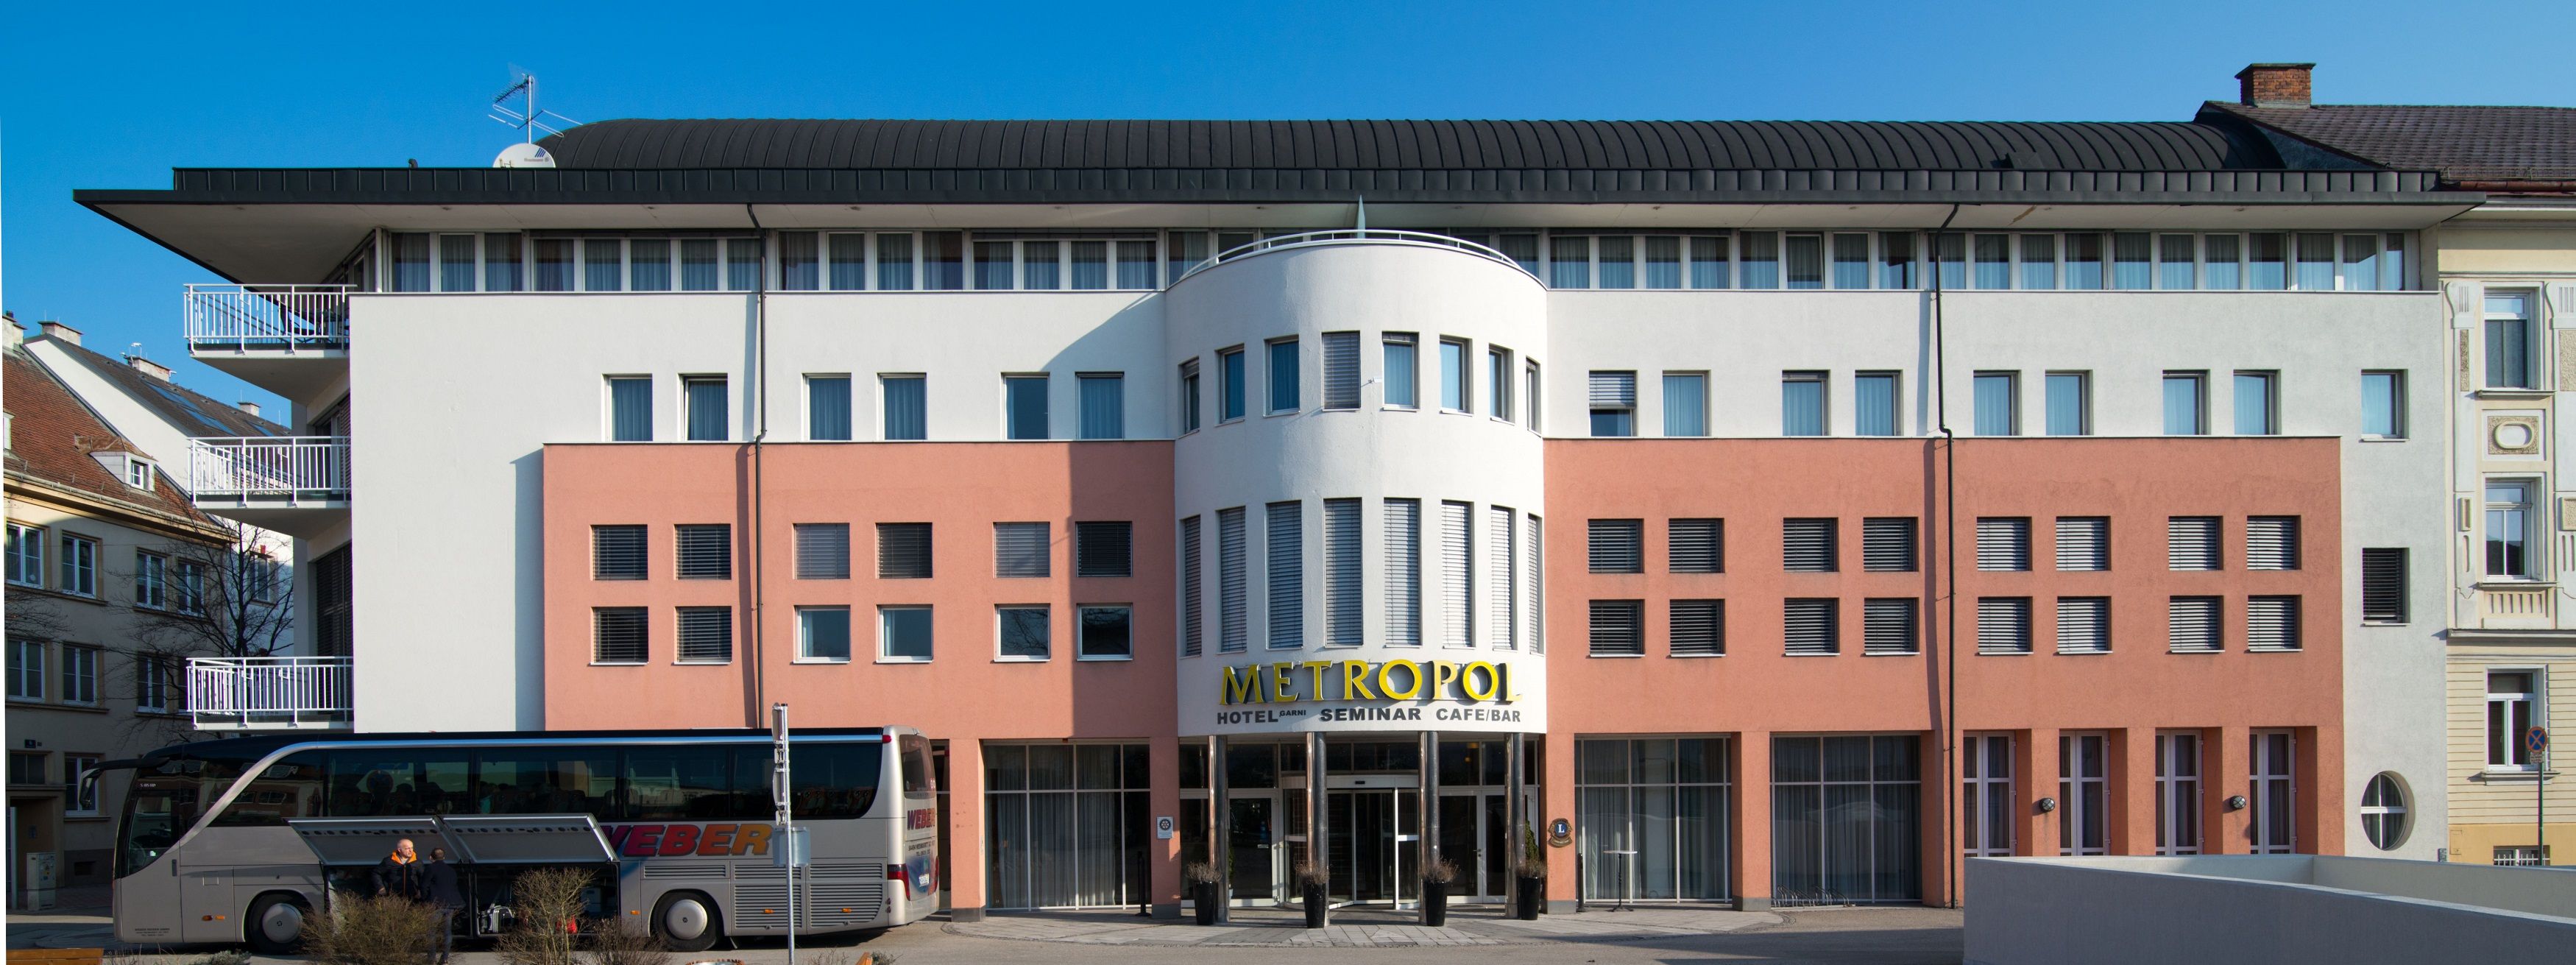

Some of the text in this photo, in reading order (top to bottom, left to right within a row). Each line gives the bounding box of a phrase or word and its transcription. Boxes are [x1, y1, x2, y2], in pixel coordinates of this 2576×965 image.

[1219, 659, 1523, 705] METROPOL
[1217, 710, 1278, 724] HOTEL
[1320, 707, 1422, 721] SEMINAR
[1436, 708, 1521, 722] CAFE/BAR
[907, 807, 935, 830] WEBER
[1558, 824, 1565, 833] L
